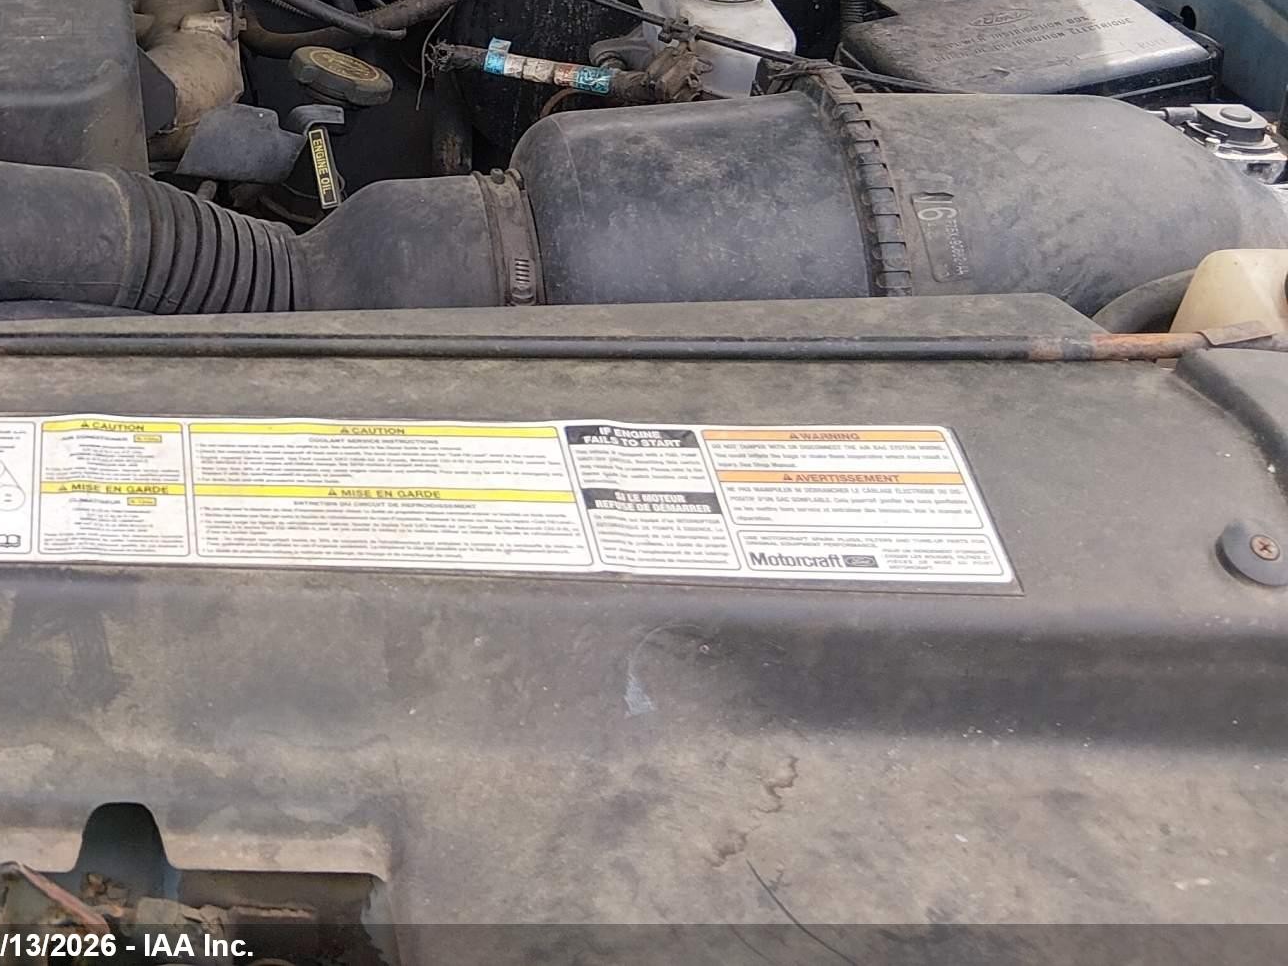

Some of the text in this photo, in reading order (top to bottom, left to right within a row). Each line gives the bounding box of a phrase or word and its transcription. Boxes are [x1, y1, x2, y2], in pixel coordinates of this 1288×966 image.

[312, 138, 332, 195] ENGINE OIL
[92, 421, 145, 432] CAUTION
[352, 427, 405, 435] CAUTION
[599, 426, 661, 440] IF ENGINE
[799, 432, 861, 440] WARNING
[583, 435, 681, 447] FAILS TO START
[795, 474, 900, 483] AVERTISSEMENT
[71, 483, 102, 492] MISE
[126, 486, 169, 494] GARDE
[340, 489, 441, 498] MISE EN GARDE
[614, 491, 687, 503] SI LE MOTEUR
[594, 499, 636, 511] REFUSE
[636, 503, 653, 512] DE
[748, 552, 844, 568] Motorcraft
